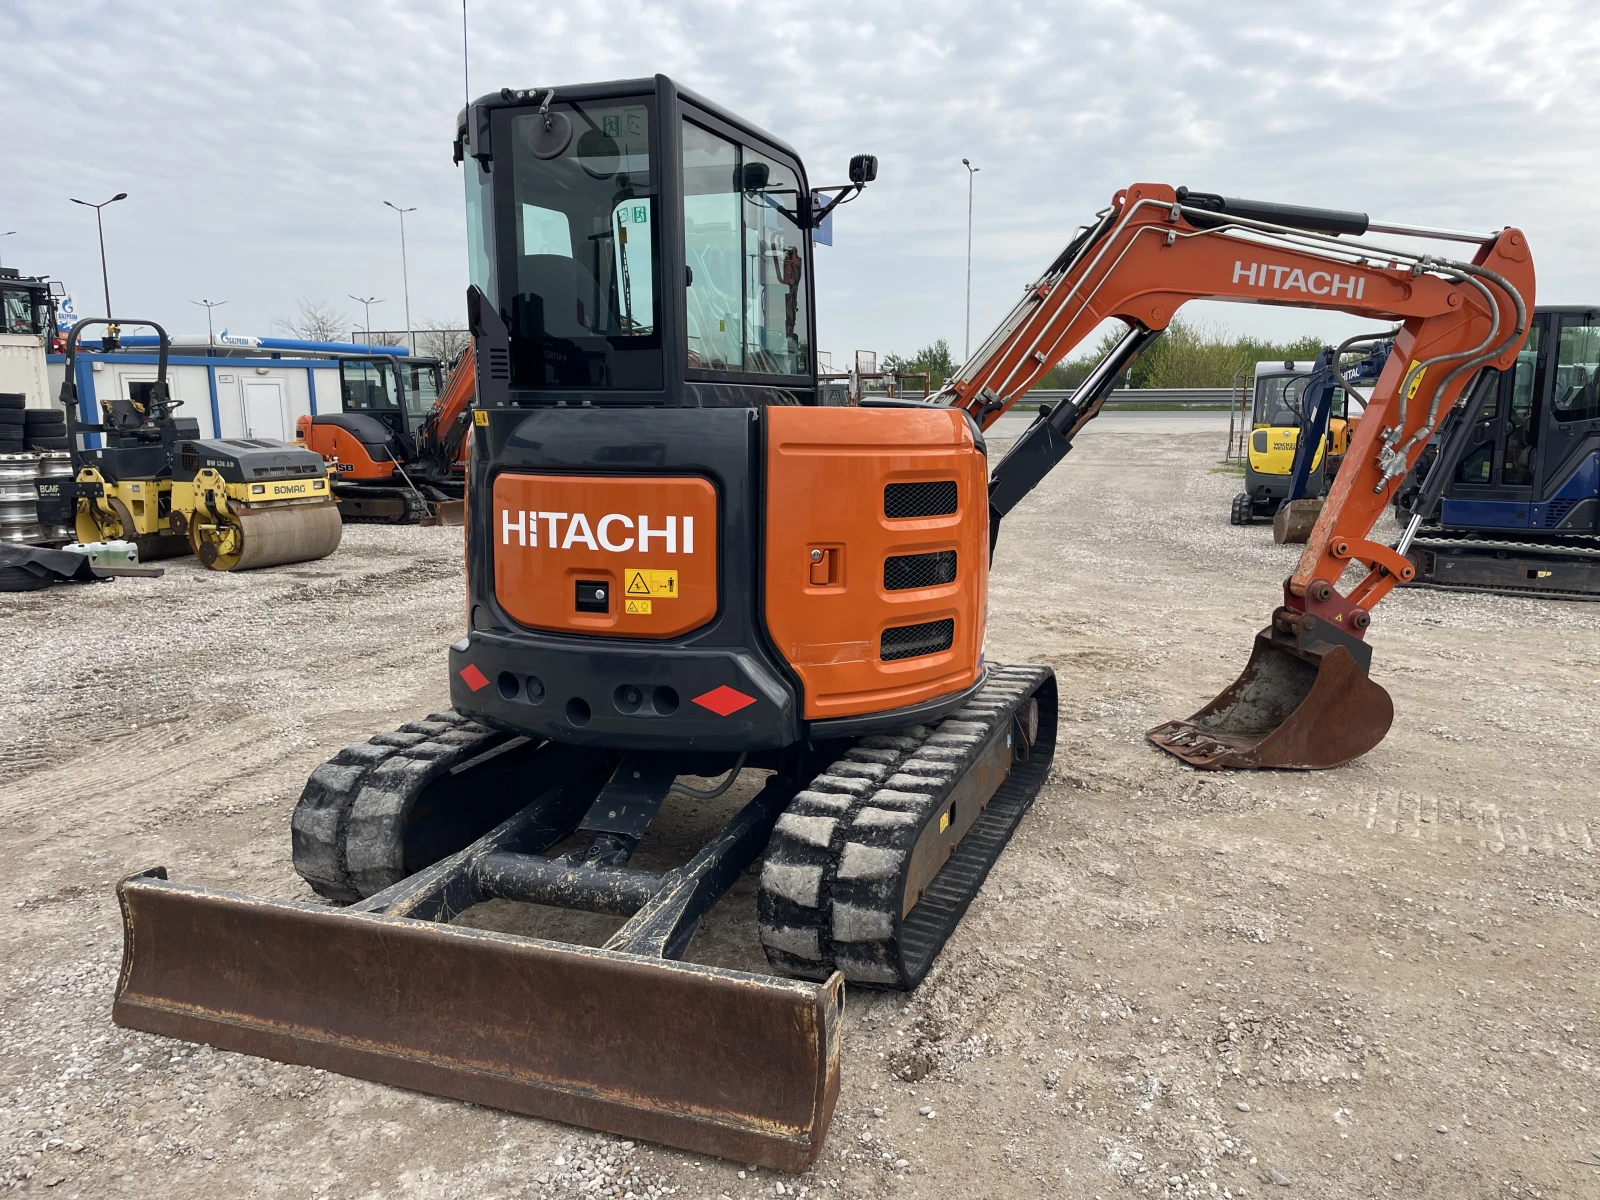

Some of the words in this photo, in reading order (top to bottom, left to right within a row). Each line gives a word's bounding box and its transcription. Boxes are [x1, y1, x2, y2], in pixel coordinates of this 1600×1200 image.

[1232, 261, 1366, 300] HITACHI
[228, 337, 249, 345] GAZPROM
[274, 484, 306, 494] BOMAG
[502, 509, 694, 554] HITACHI
